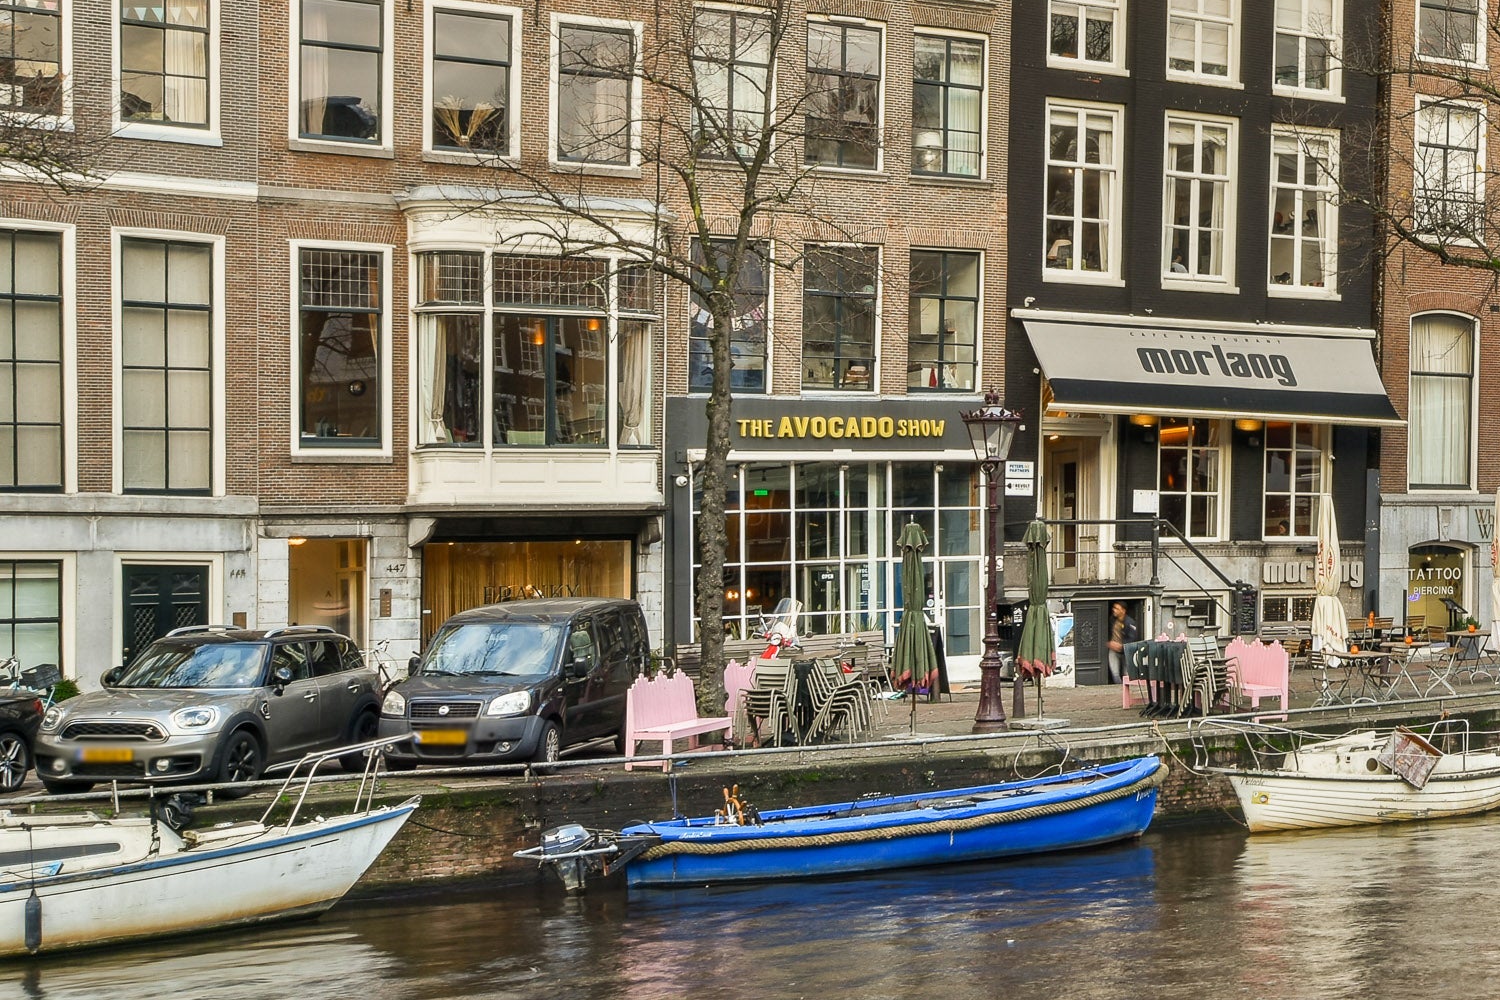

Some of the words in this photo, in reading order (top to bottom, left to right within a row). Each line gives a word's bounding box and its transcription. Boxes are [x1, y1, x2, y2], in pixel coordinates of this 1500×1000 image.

[1179, 334, 1282, 344] RESTAURANT
[1136, 344, 1298, 387] morlang
[736, 419, 774, 438] THE
[777, 416, 894, 439] AVOCADO
[896, 419, 945, 438] SHOW
[386, 563, 406, 573] 447
[1263, 561, 1364, 588] morng
[1408, 567, 1462, 581] TATTOO
[1413, 586, 1454, 595] PIERCING
